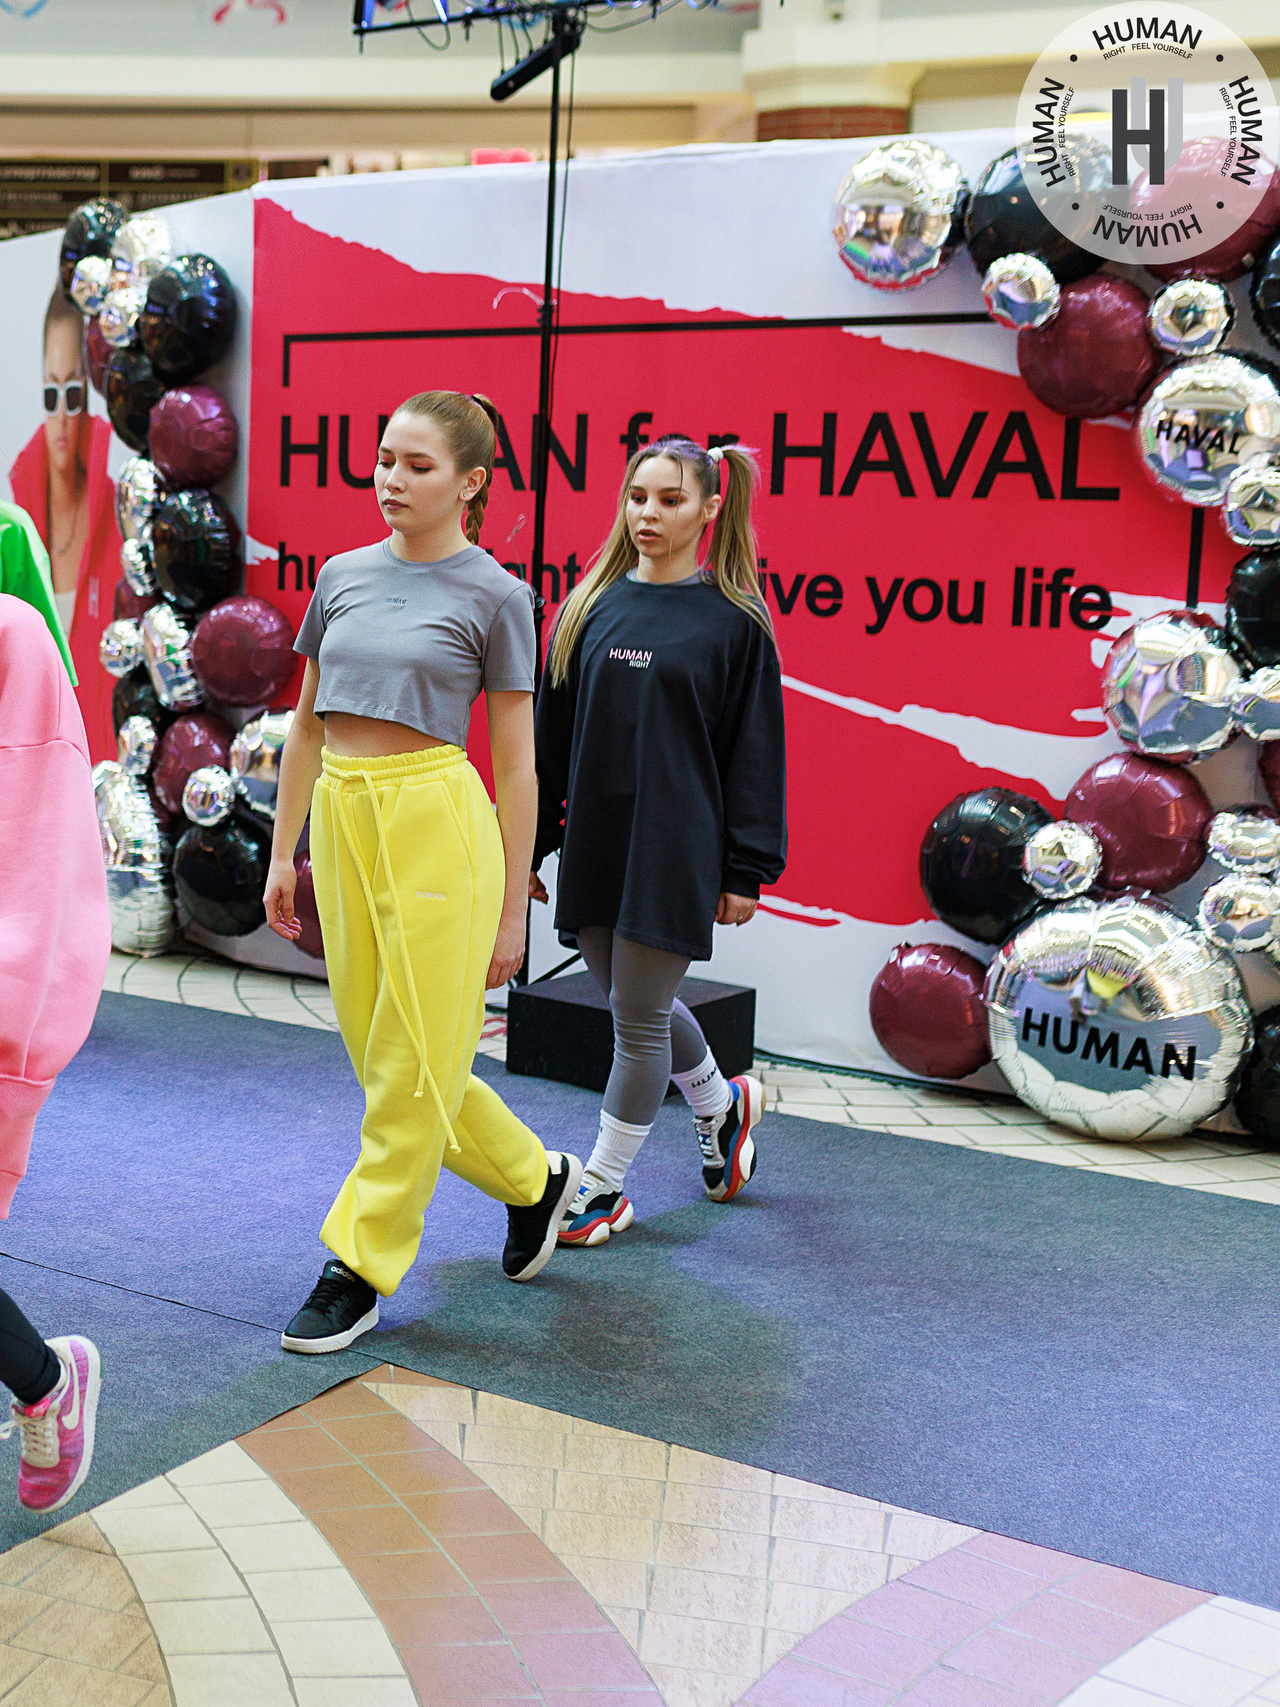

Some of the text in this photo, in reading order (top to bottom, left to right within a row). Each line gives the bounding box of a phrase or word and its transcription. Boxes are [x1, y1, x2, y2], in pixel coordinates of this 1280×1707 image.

[1155, 418, 1240, 455] HAVAL
[280, 413, 588, 492] HUAN
[770, 411, 1121, 501] HAVAL
[757, 558, 844, 618] ive
[865, 575, 985, 635] you
[1011, 566, 1113, 631] life
[609, 647, 653, 663] HUMAN
[629, 660, 650, 669] RIGHT
[415, 890, 447, 902] HUMAN
[1022, 1006, 1197, 1081] HUMAN
